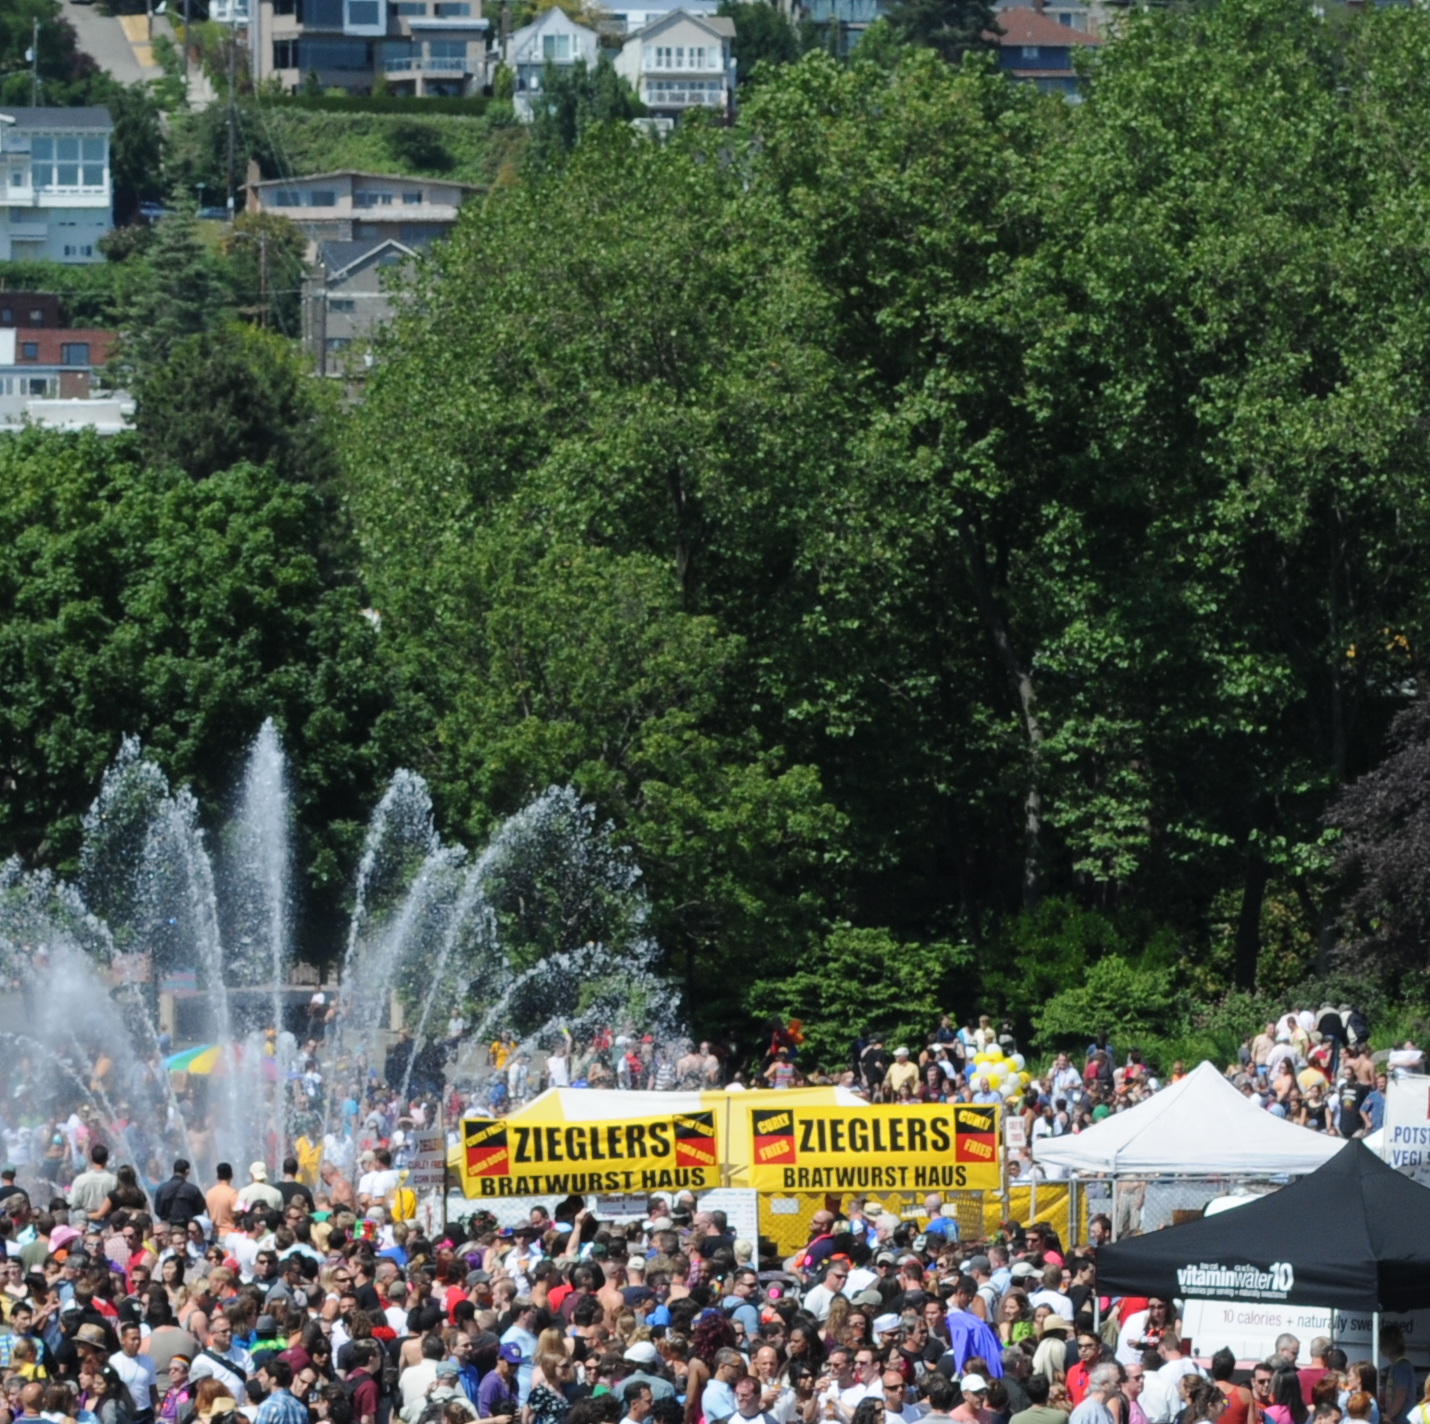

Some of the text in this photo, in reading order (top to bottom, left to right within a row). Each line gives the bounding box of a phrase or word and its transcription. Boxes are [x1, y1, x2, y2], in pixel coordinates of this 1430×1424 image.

[757, 1113, 791, 1134] CURLY
[958, 1110, 992, 1131] CURLY
[514, 1122, 671, 1163] ZIEGLERS
[798, 1117, 950, 1153] ZIEGLERS
[759, 1139, 791, 1161] FRIES
[963, 1138, 993, 1159] FRIES
[481, 1167, 705, 1196] BRATWURST HAUS
[783, 1165, 967, 1188] BRATWURST HAUS
[1223, 1309, 1234, 1322] 10
[1237, 1310, 1282, 1327] calories
[1297, 1314, 1348, 1336] naturally
